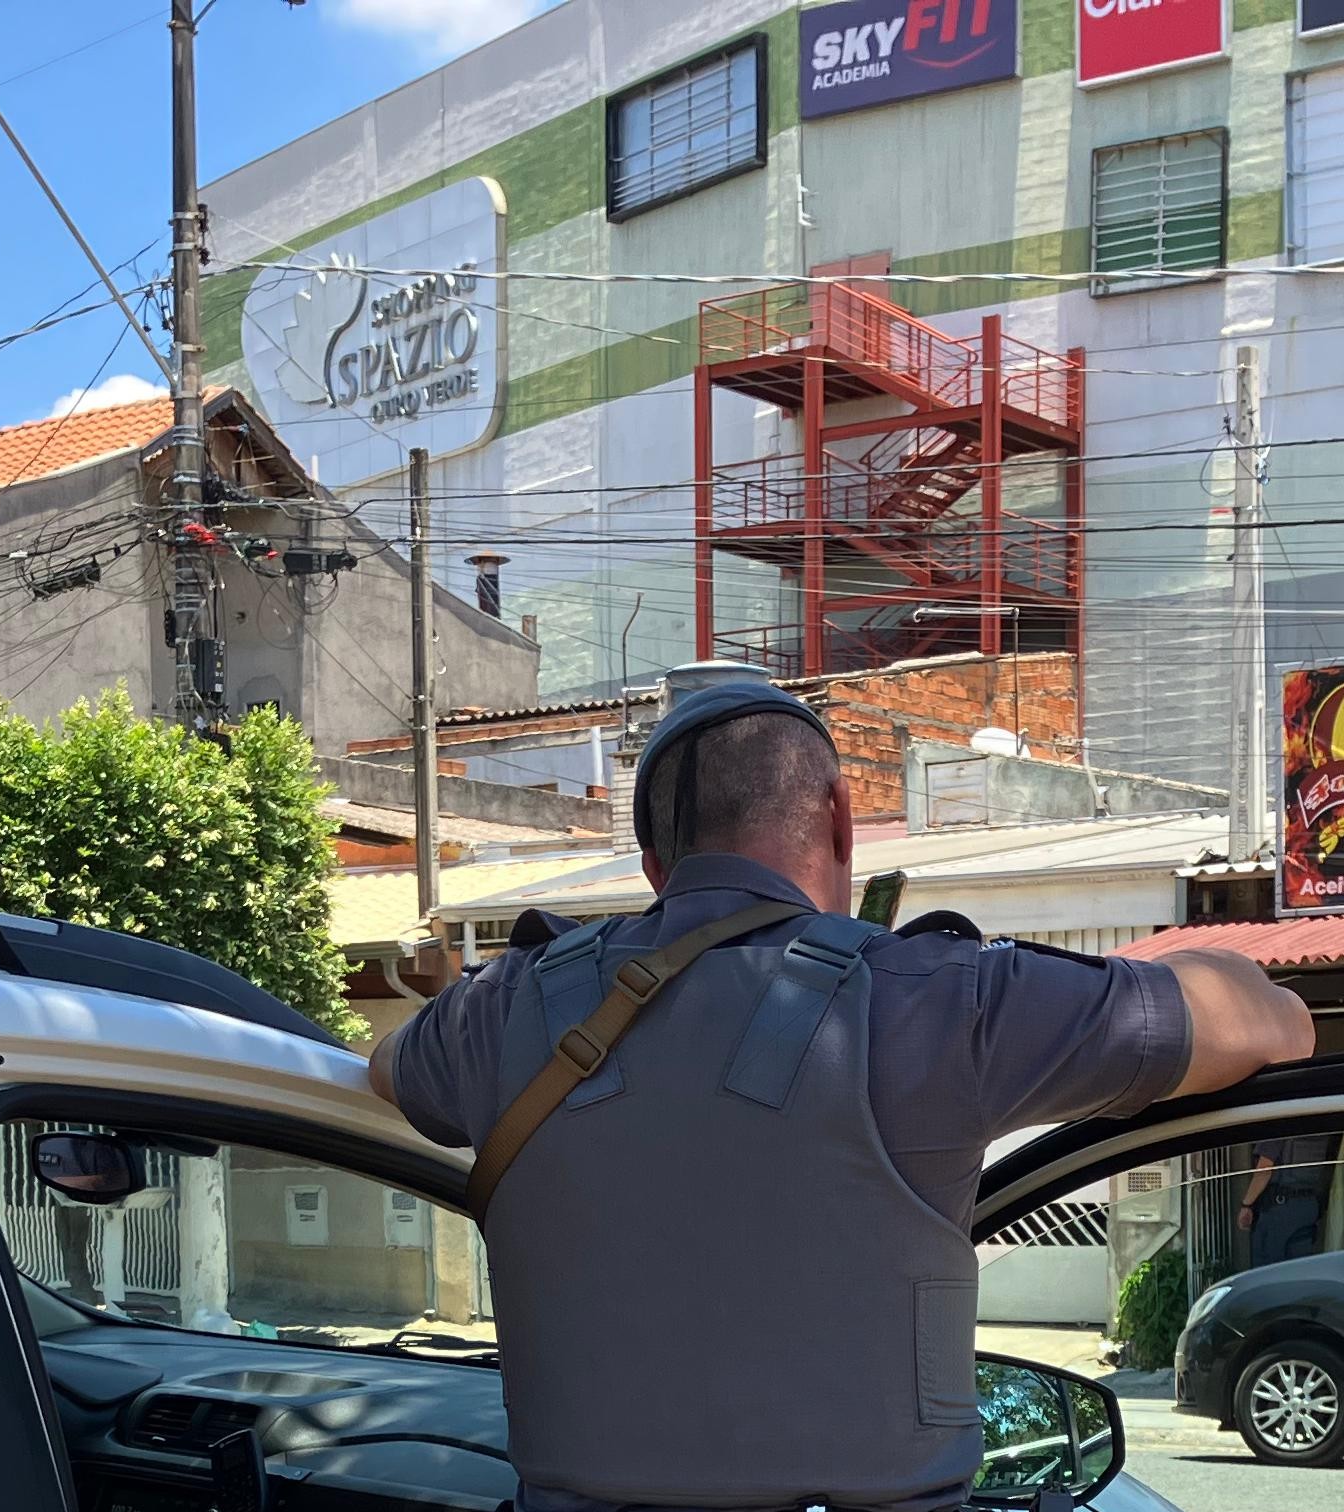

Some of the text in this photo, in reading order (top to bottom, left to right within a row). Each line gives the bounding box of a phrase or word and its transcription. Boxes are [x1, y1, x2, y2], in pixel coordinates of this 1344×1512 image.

[812, 61, 891, 90] ACADEMIA
[338, 307, 478, 405] SPAZIO
[423, 368, 478, 407] VERDE
